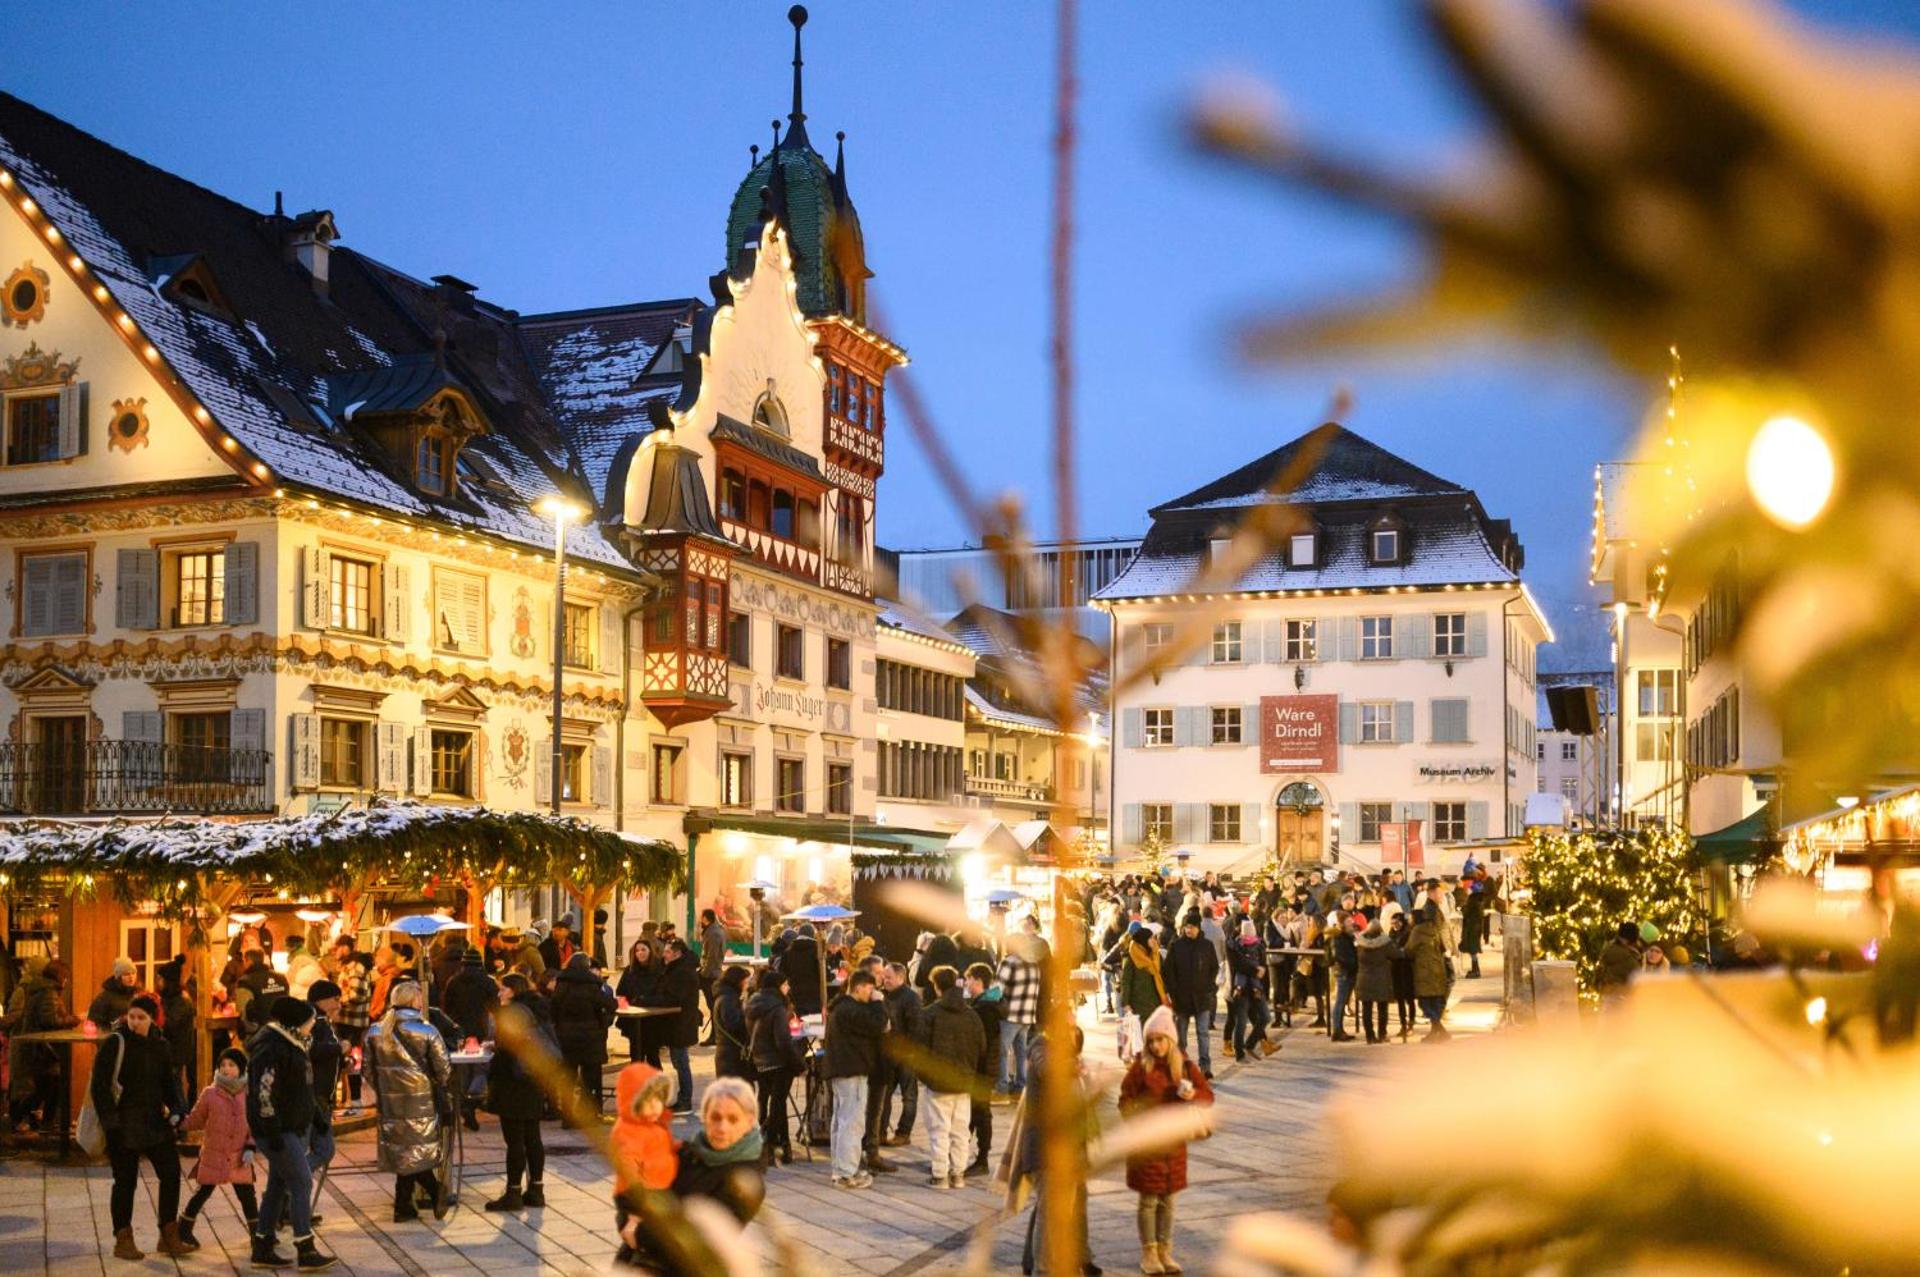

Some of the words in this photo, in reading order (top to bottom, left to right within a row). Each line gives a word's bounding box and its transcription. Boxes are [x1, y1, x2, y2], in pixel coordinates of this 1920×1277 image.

[757, 682, 793, 713] Johann
[1275, 707, 1316, 721] Ware
[1275, 722, 1322, 738] Dirndl
[1420, 767, 1462, 776] Museum
[1464, 767, 1496, 776] Archiv
